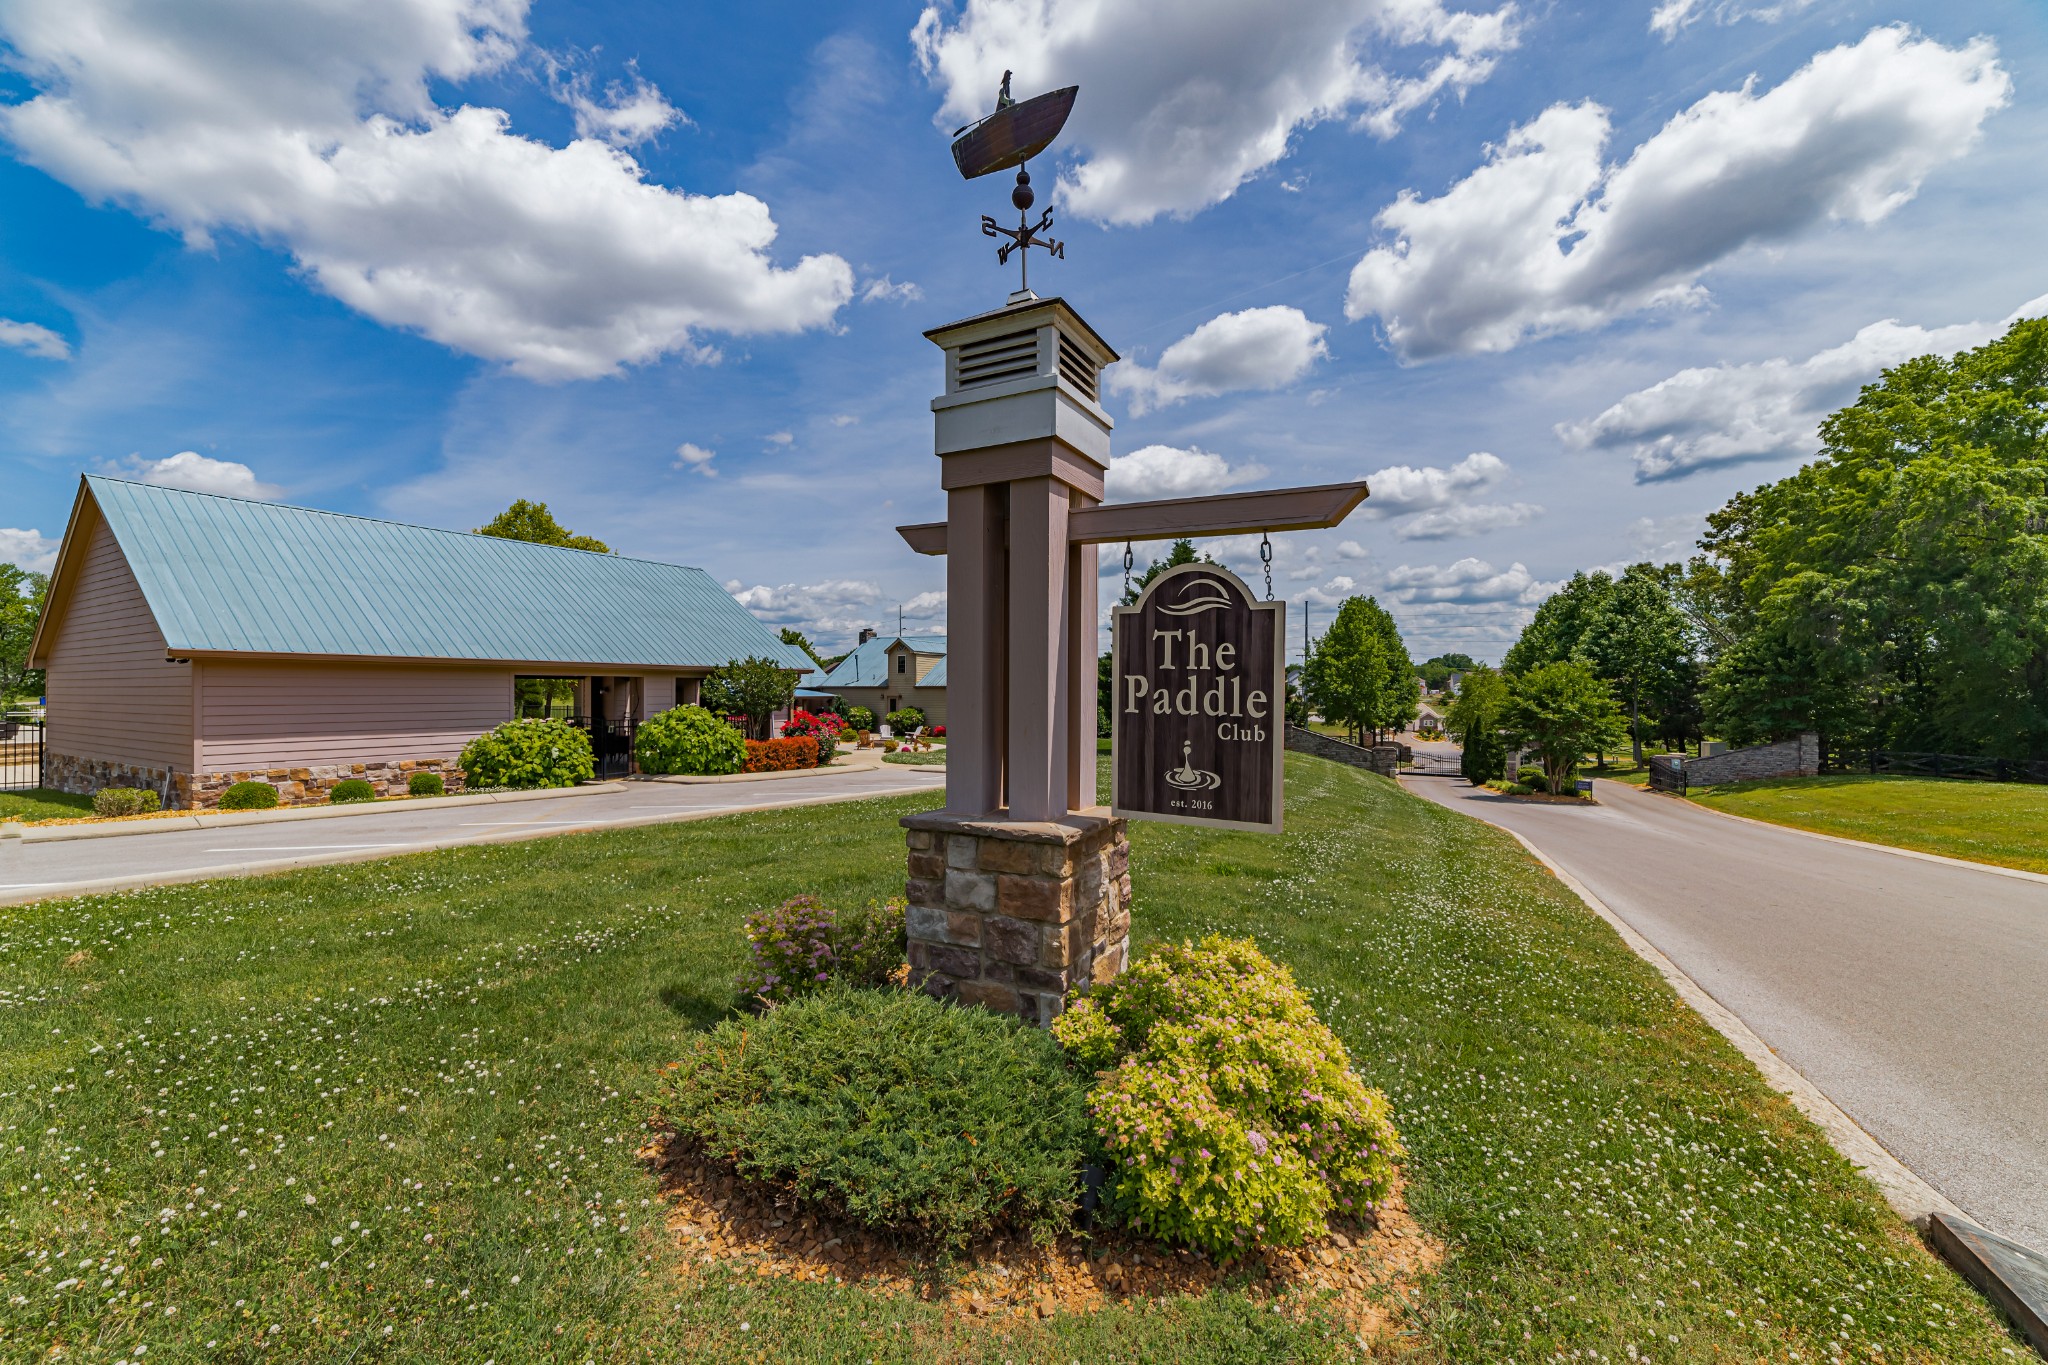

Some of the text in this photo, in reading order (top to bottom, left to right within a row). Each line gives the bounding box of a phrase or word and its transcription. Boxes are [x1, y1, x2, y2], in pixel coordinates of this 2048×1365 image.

[1152, 629, 1236, 671] The
[1124, 674, 1268, 719] Paddle
[1217, 722, 1266, 742] Club
[1170, 799, 1213, 810] est. 2016
